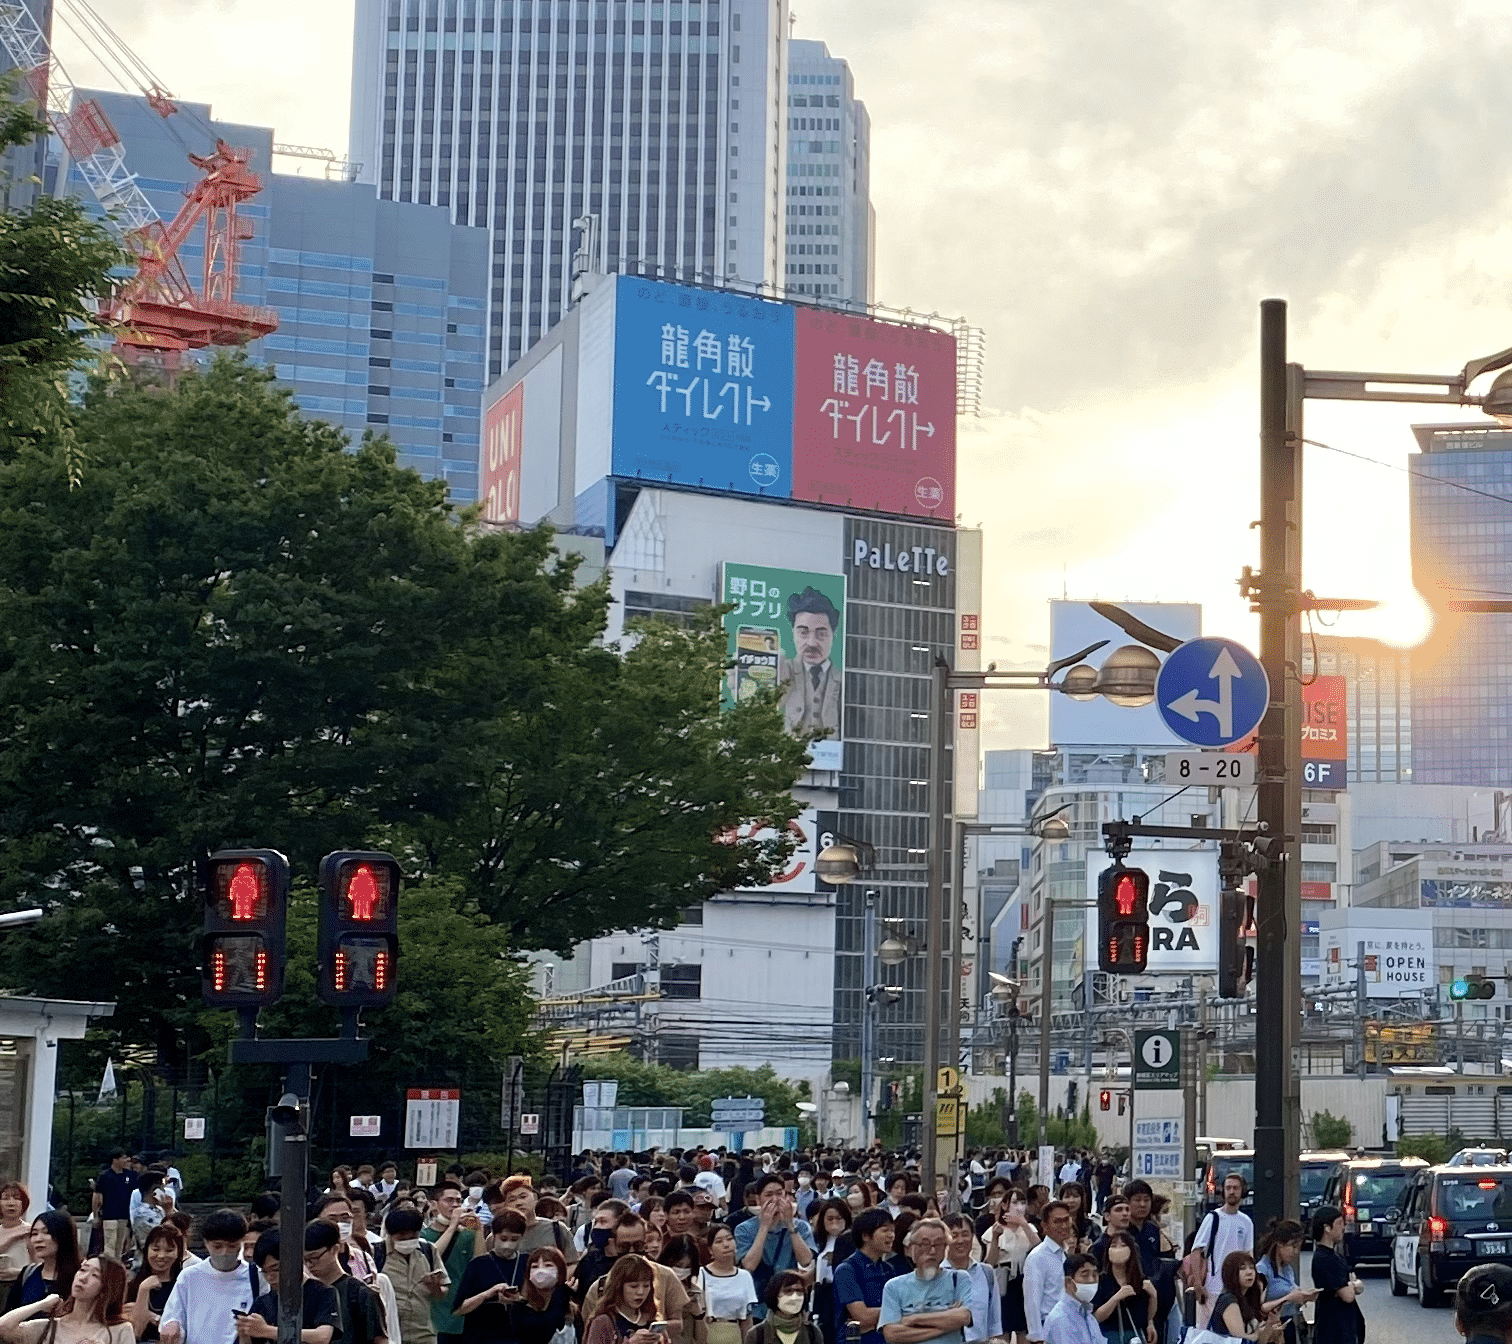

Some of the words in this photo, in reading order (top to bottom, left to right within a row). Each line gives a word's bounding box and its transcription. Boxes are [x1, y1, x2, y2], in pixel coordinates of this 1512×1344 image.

[661, 322, 755, 378] 龍角散
[646, 370, 771, 425] ダイレクト
[833, 353, 919, 405] 龍角散
[490, 410, 516, 472] UNI
[819, 398, 936, 450] ダイレクト
[729, 577, 780, 598] 野口の
[1304, 762, 1332, 783] 6F
[1386, 956, 1425, 968] OPEN
[1386, 972, 1426, 982] HOUSE
